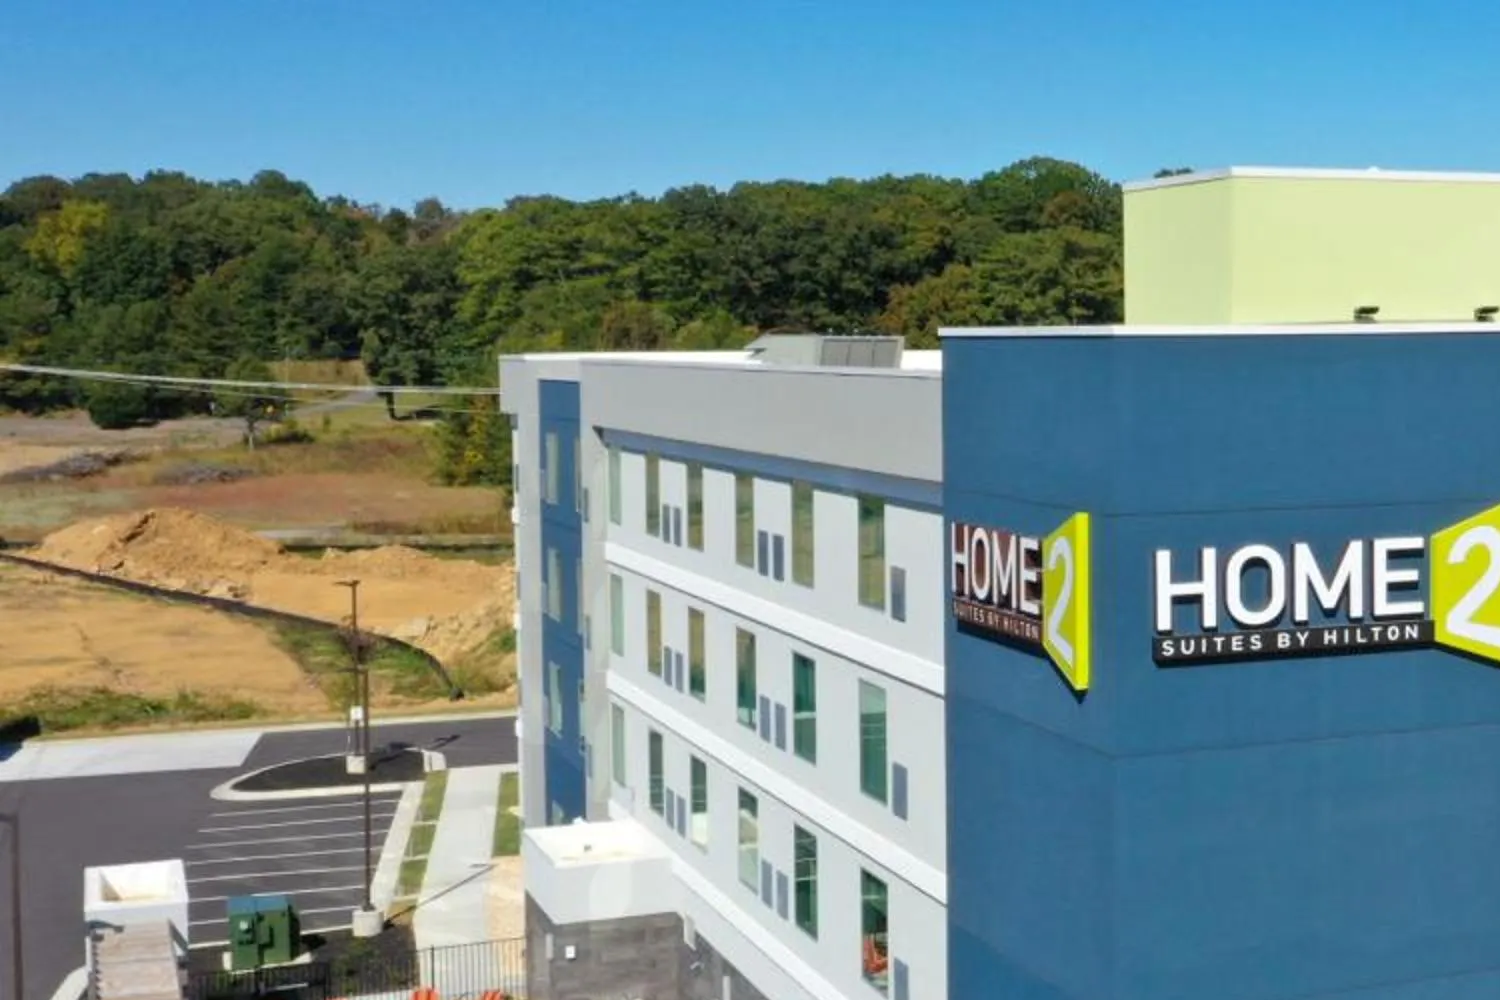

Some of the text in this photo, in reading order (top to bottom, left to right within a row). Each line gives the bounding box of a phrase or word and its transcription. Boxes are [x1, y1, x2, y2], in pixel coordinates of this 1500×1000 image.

[951, 521, 1073, 668] HOME 2
[954, 599, 985, 623] TES
[1155, 536, 1425, 632] HOME
[1162, 624, 1419, 657] SUITES BY HILTON
